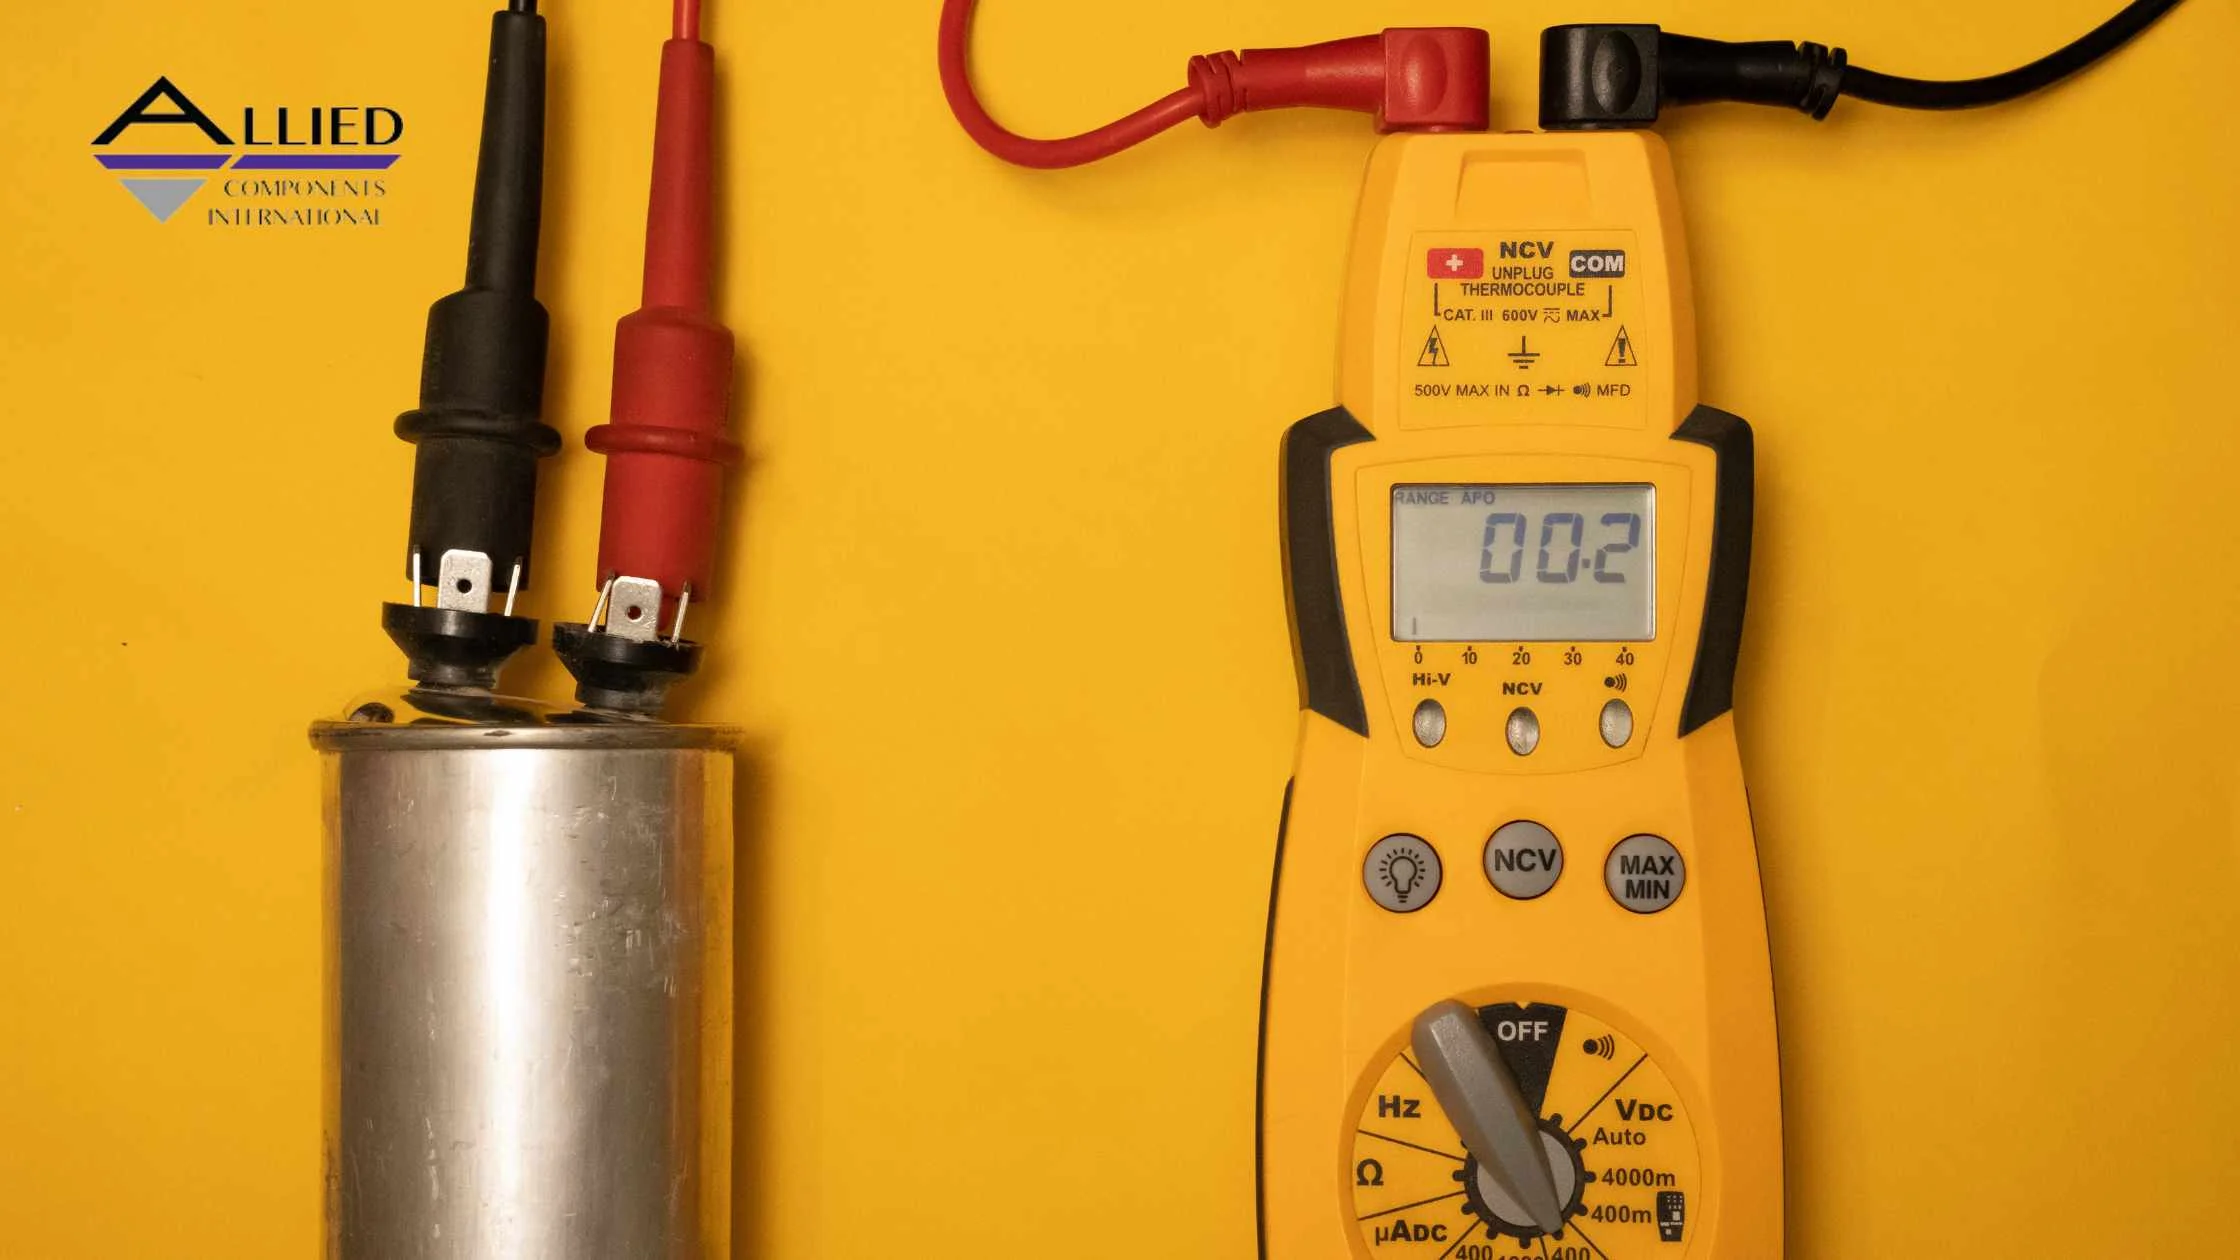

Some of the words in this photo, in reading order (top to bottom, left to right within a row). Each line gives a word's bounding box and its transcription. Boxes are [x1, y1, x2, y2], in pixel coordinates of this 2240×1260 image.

[1500, 241, 1554, 259] NCV
[1571, 255, 1624, 272] COM
[1492, 266, 1554, 280] UNPLUG
[1460, 283, 1585, 296] THERMOCOUPLE
[1444, 309, 1476, 321] CAT.
[1481, 310, 1493, 321] III
[1502, 310, 1538, 321] 600V
[1566, 310, 1600, 321] MAX
[1415, 384, 1450, 397] 500V
[1456, 384, 1489, 396] MAX
[1495, 384, 1510, 396] IN
[1597, 384, 1631, 396] MFD
[1394, 491, 1449, 504] RANGE
[1461, 492, 1495, 504] APO
[1479, 512, 1641, 583] 00.2
[1414, 653, 1423, 664] 0
[1462, 653, 1477, 665] 10
[1512, 653, 1531, 665] 20
[1563, 653, 1582, 665] 30
[1616, 653, 1634, 665] 40
[1412, 673, 1451, 685] Hi-V
[1502, 682, 1543, 695] NCV
[1494, 849, 1557, 871] NCV
[1620, 855, 1675, 875] MAX
[1625, 880, 1670, 899] MIN
[1498, 1021, 1549, 1041] OFF
[1378, 1095, 1421, 1118] Hz
[1593, 1127, 1646, 1146] Auto
[1602, 1168, 1676, 1187] 4000m
[1591, 1205, 1652, 1224] 400m
